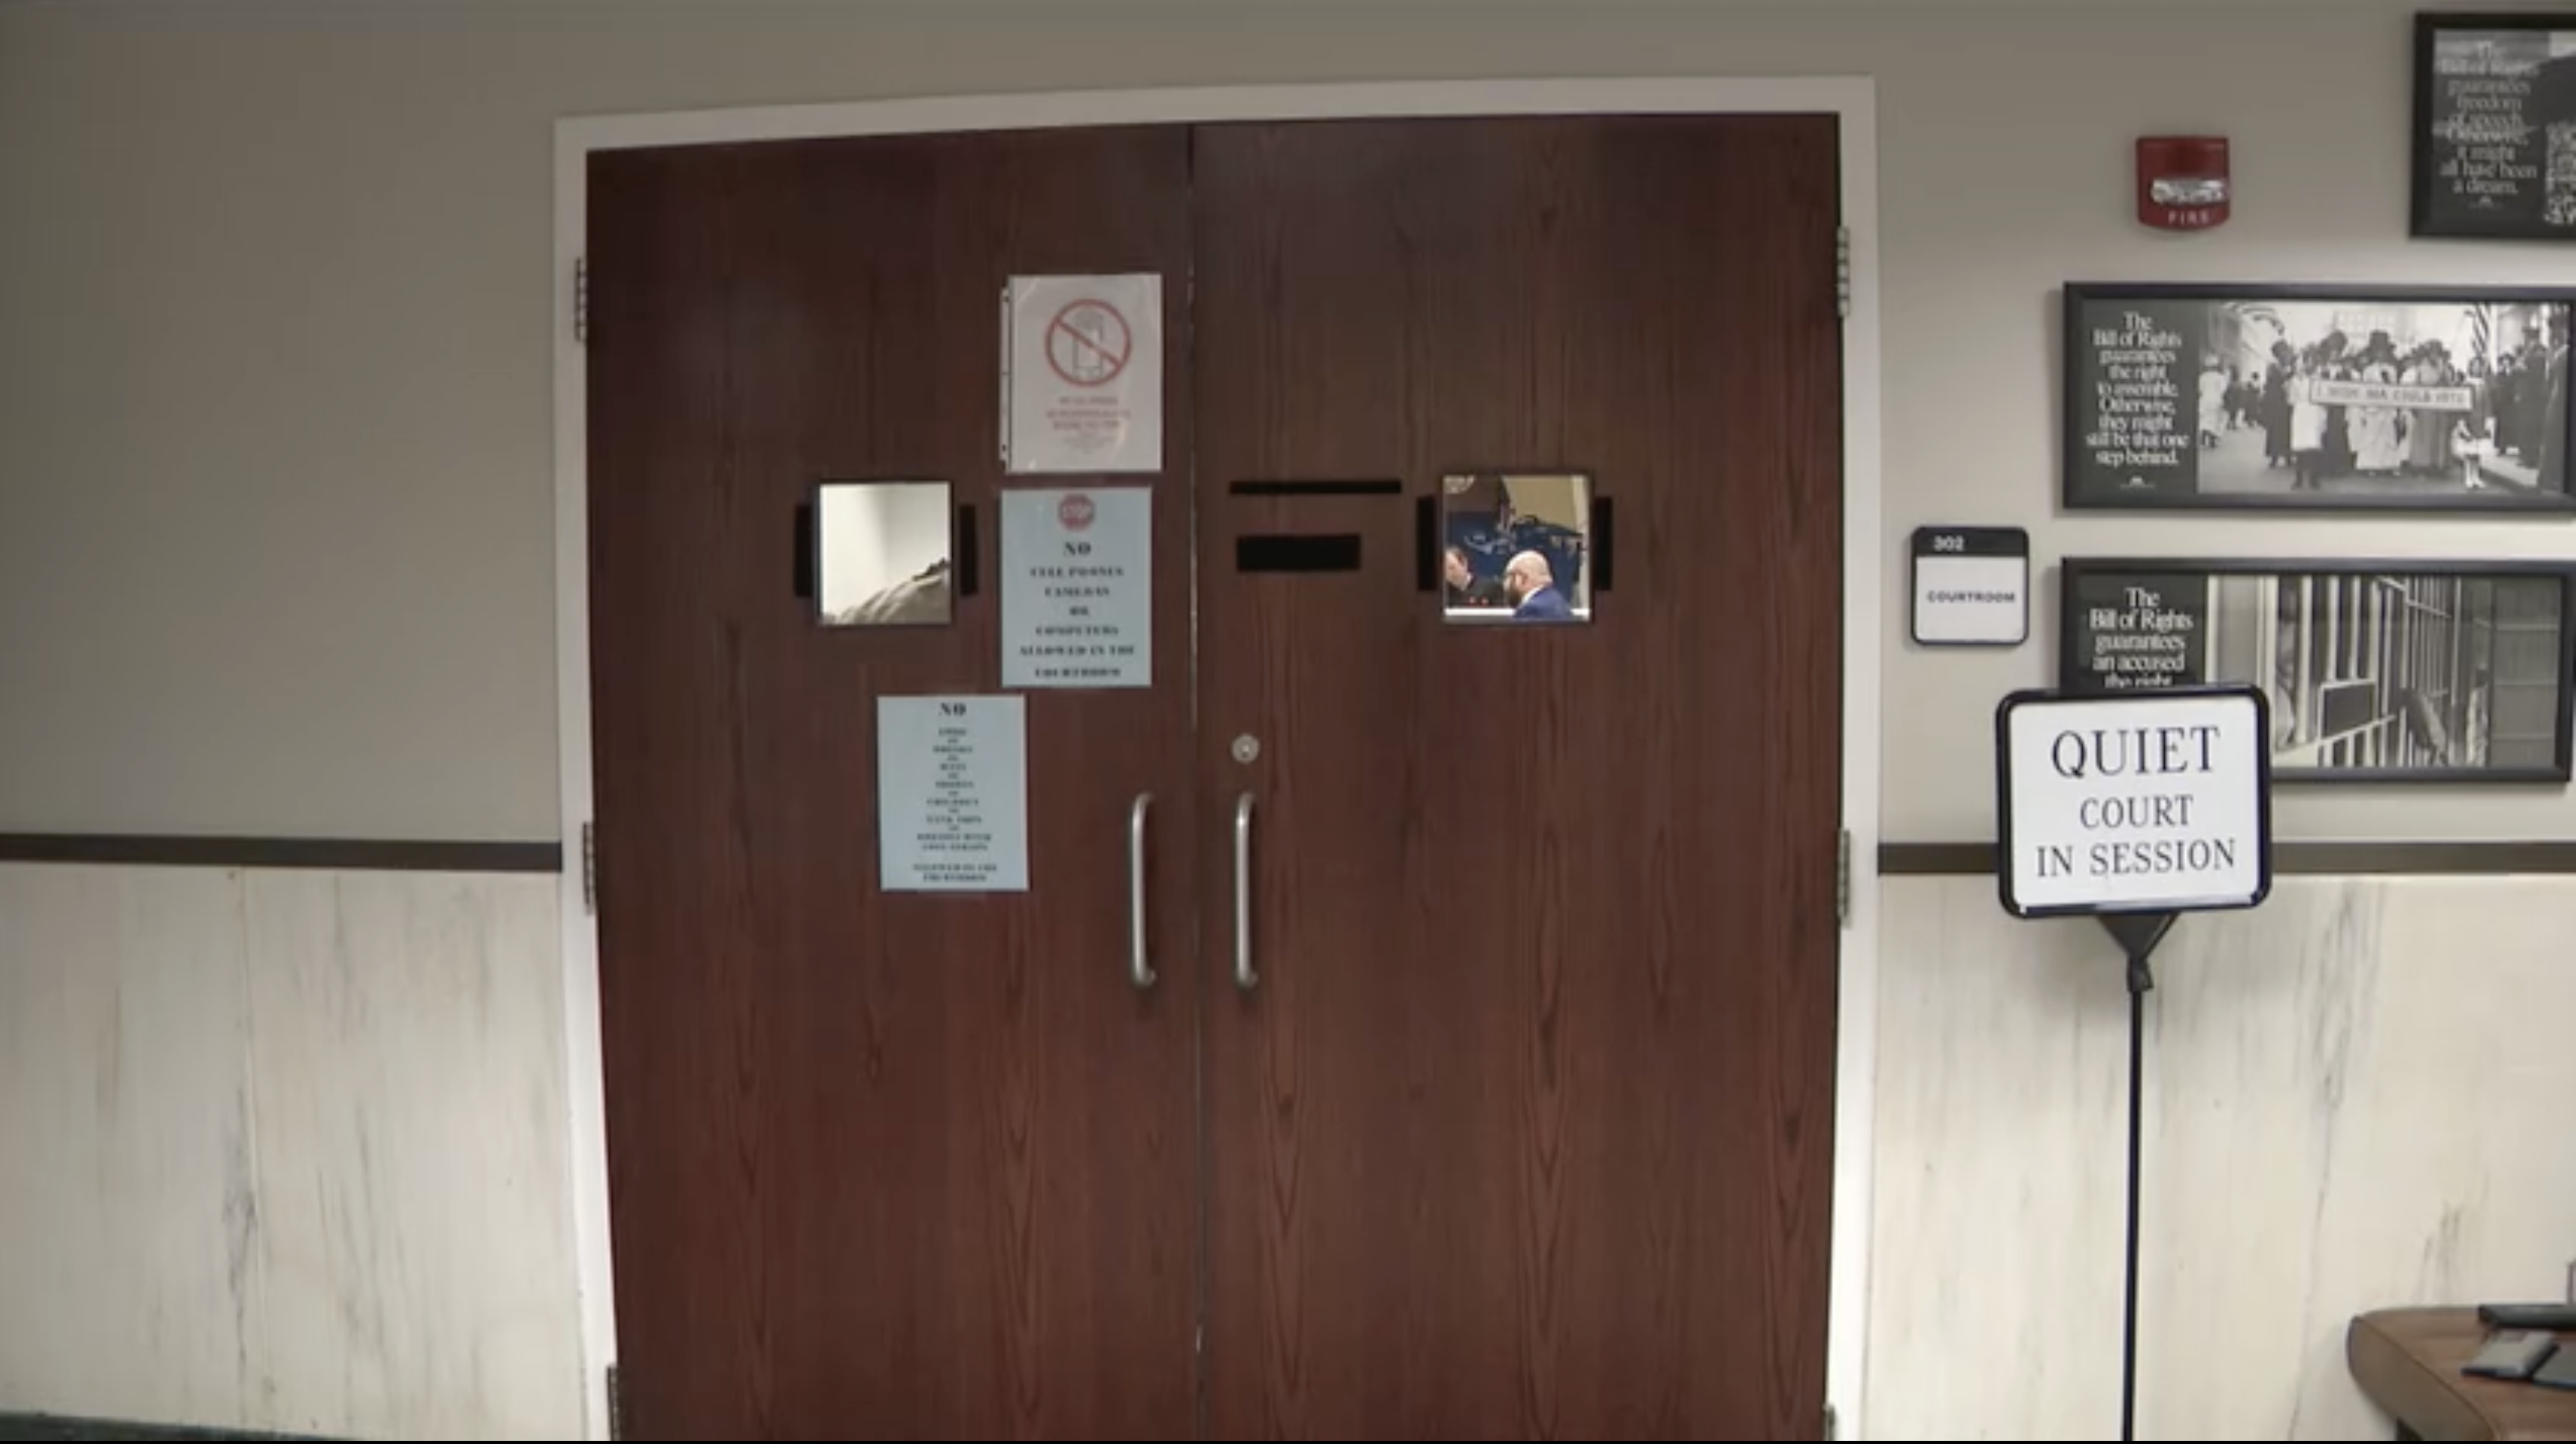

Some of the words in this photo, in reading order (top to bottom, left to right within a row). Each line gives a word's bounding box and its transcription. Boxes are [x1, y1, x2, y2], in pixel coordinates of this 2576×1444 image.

[2168, 210, 2210, 225] FIRE
[2124, 311, 2153, 331] The
[2093, 329, 2118, 346] Bill
[2119, 330, 2136, 346] of
[2137, 330, 2182, 350] Rights
[2099, 349, 2176, 366] guarantees
[2108, 364, 2131, 380] the
[2134, 364, 2167, 382] right
[2097, 381, 2112, 396] to
[2098, 415, 2127, 433] they
[2131, 415, 2172, 432] might
[2163, 434, 2189, 447] one
[2095, 450, 2124, 468] step
[1063, 542, 1092, 556] NO
[1934, 535, 1965, 551] 302
[1927, 590, 2015, 604] COURTROOM
[2125, 586, 2160, 607] The
[2089, 607, 2116, 629] Bill
[2119, 607, 2139, 629] of
[2141, 608, 2194, 633] Rights
[2095, 634, 2185, 655] guarantees
[2092, 655, 2115, 671] an
[2116, 652, 2185, 672] accused
[938, 702, 966, 716] NO
[2051, 725, 2220, 779] QUIET
[2079, 794, 2193, 829] COURT
[2036, 844, 2073, 877] IN
[2089, 837, 2236, 877] SESSION
